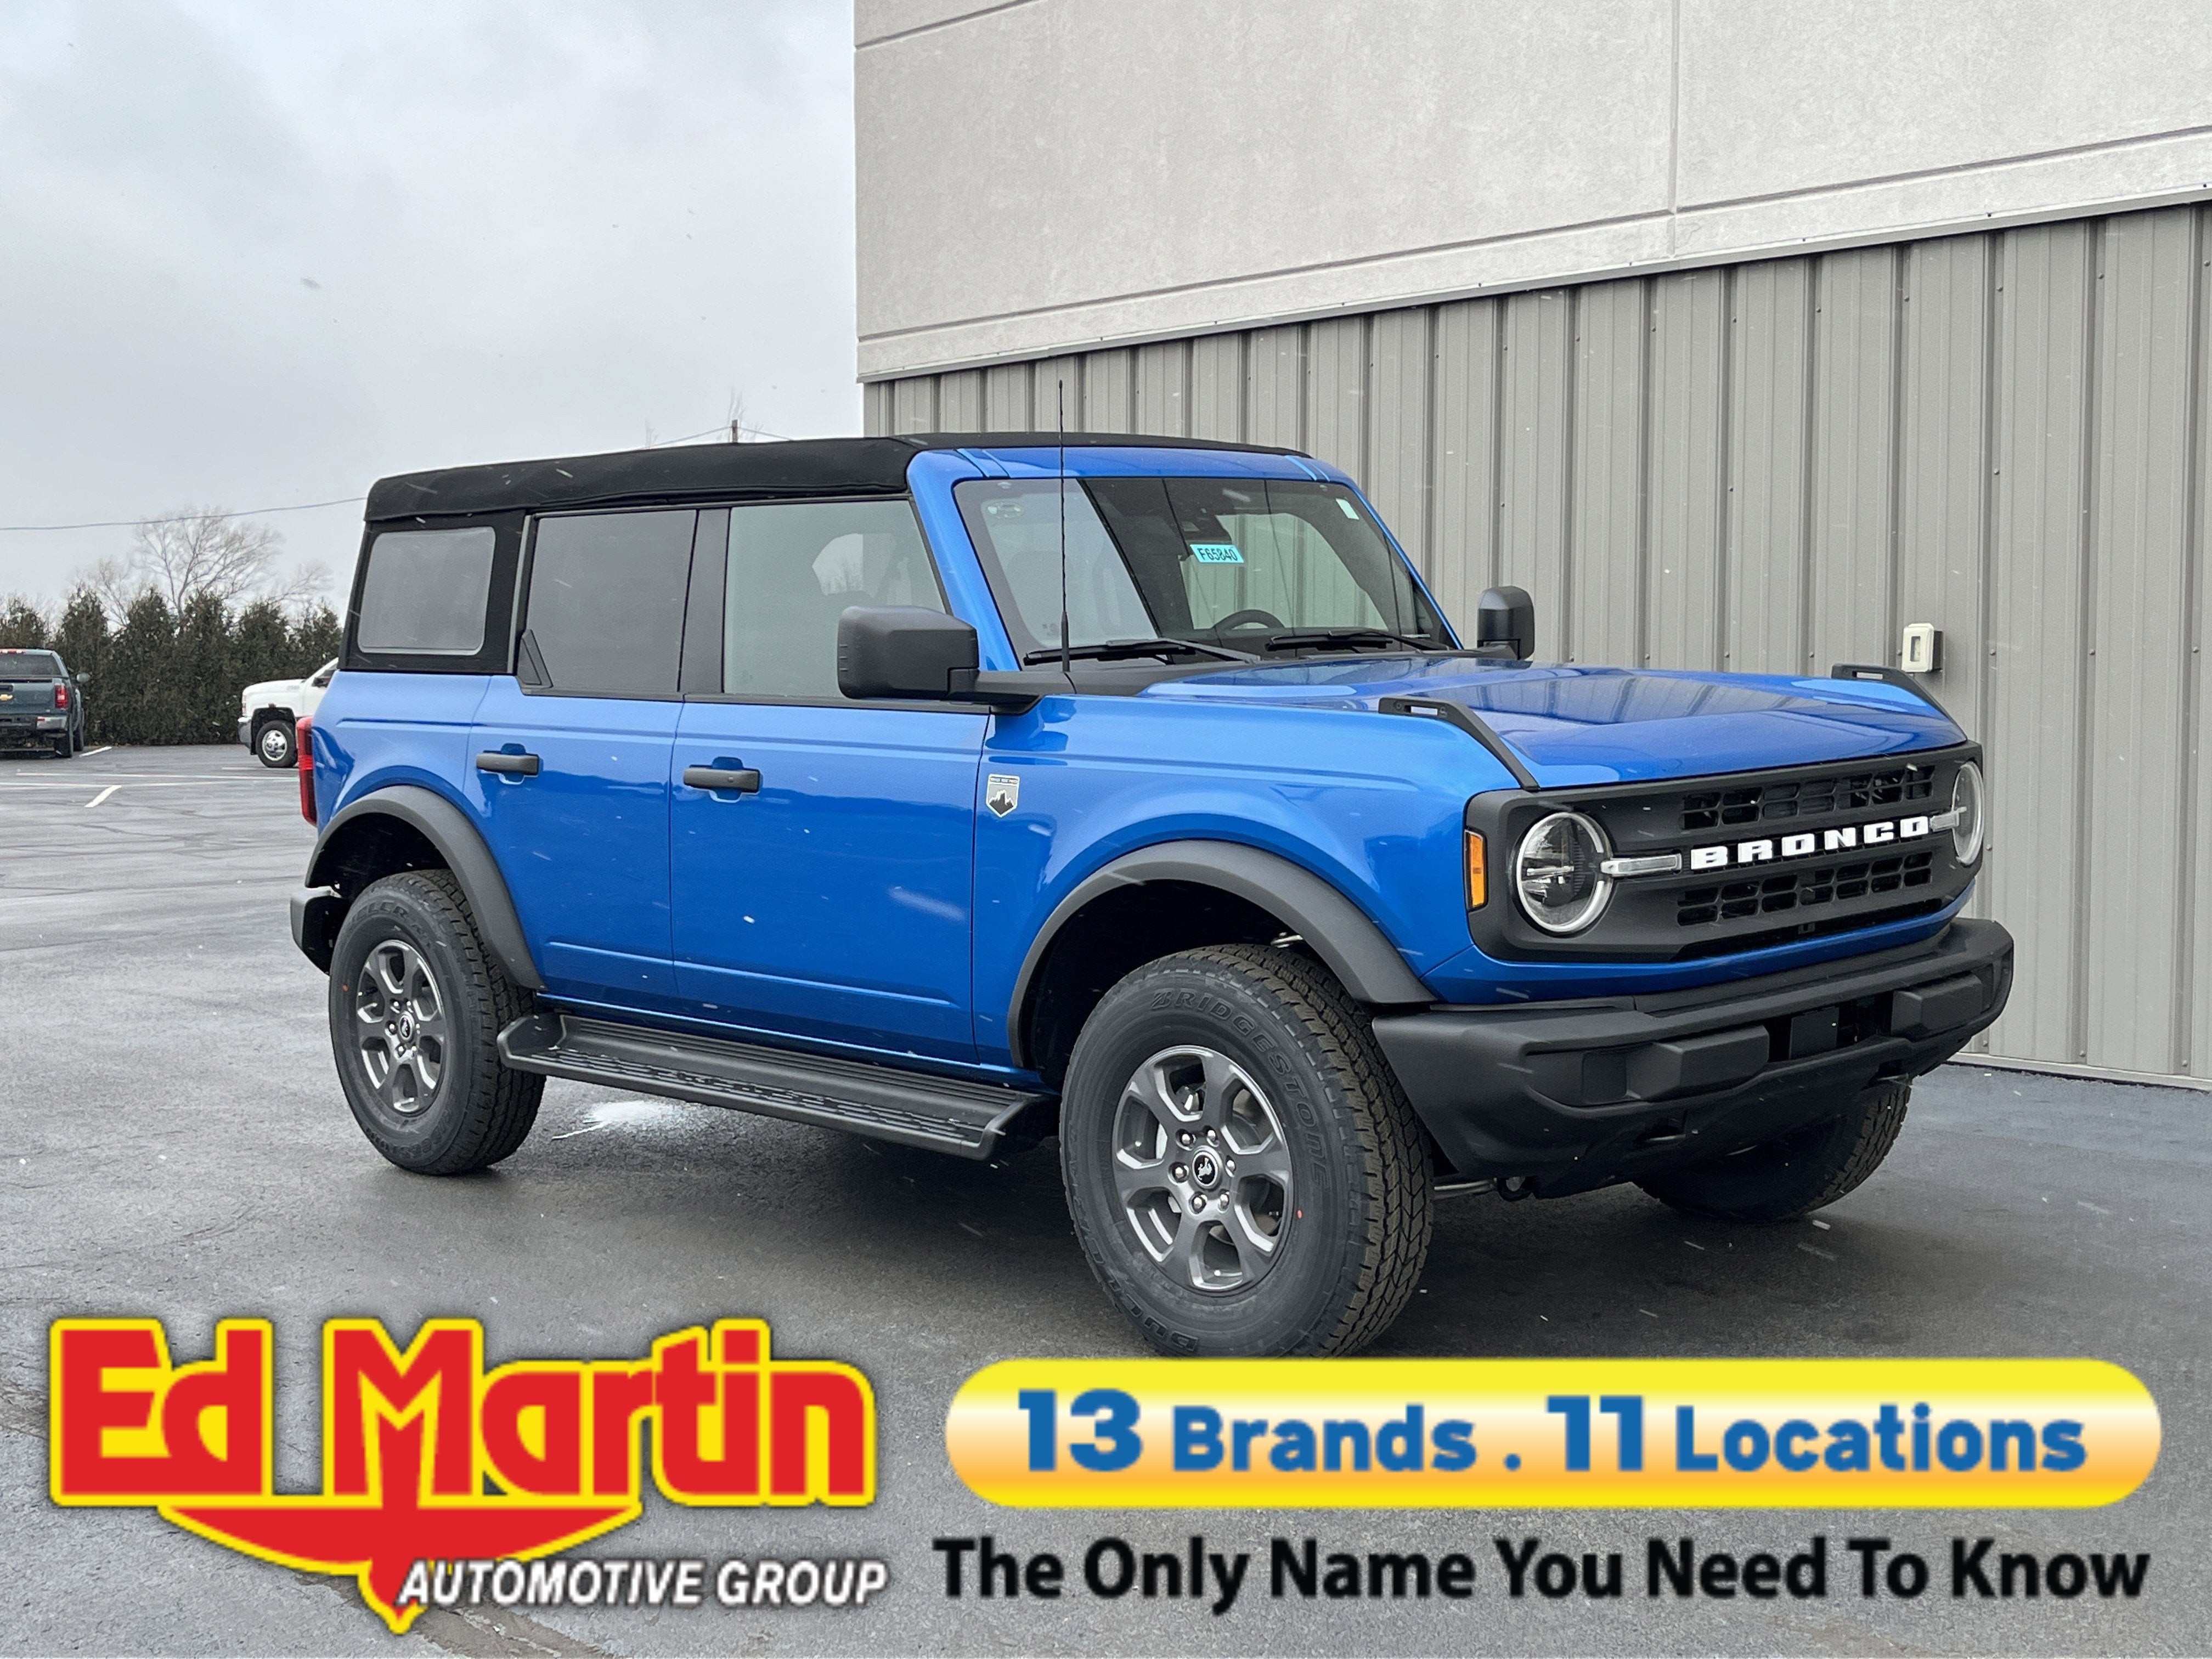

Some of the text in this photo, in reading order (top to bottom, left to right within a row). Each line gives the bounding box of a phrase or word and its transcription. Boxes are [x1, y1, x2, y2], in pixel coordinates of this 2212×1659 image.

[1197, 548, 1238, 561] F65840
[1690, 816, 1929, 870] BRONCO
[1149, 988, 1330, 1193] BRIDGESTONE
